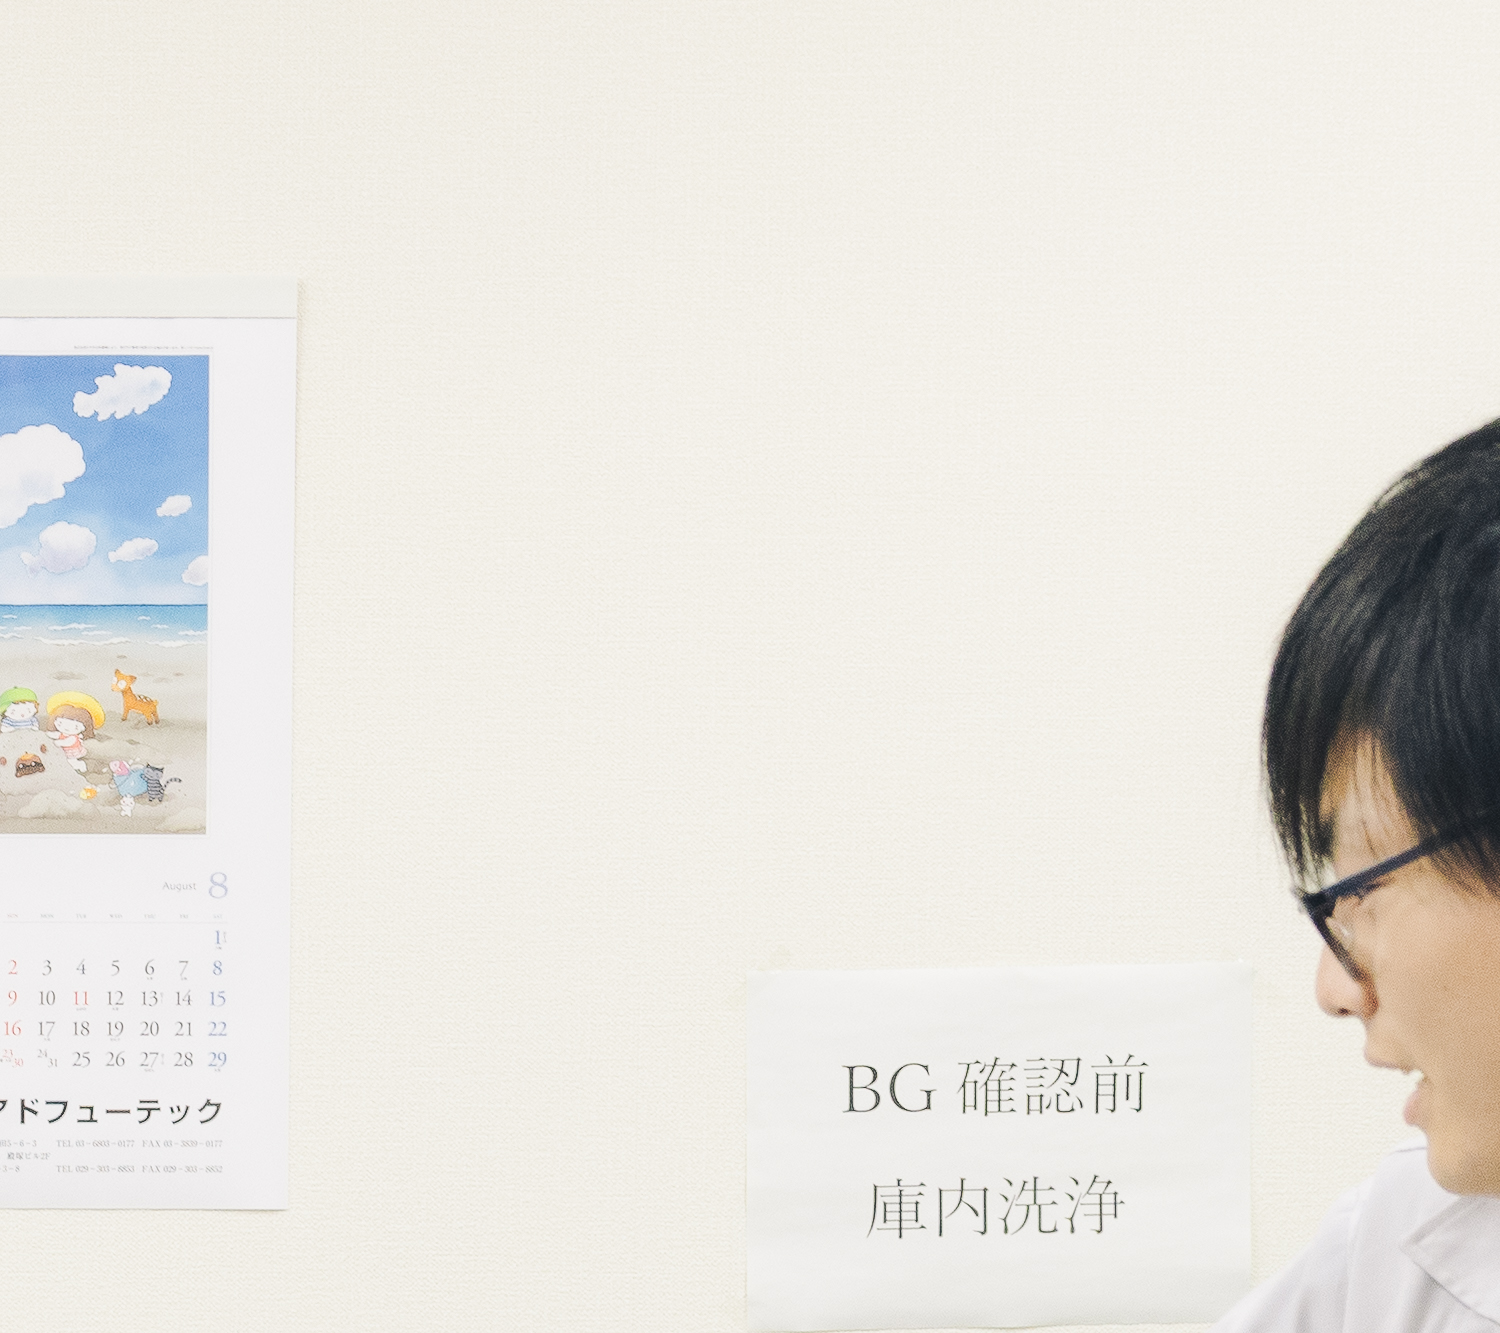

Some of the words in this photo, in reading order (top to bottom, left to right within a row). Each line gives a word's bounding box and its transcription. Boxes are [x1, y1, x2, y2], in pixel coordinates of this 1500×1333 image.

[162, 881, 197, 892] August
[208, 871, 228, 899] 8
[214, 930, 222, 946] 1
[8, 960, 18, 975] 2
[42, 960, 53, 976] 3
[76, 961, 86, 975] 4
[111, 960, 121, 975] 5
[144, 961, 155, 975] 6
[178, 960, 190, 976] 7
[212, 961, 223, 976] 8
[7, 991, 18, 1005] 9
[39, 991, 56, 1006] 10
[73, 991, 89, 1006] 11
[107, 991, 124, 1006] 12
[142, 991, 159, 1007] 13
[176, 991, 192, 1006] 14
[210, 991, 227, 1006] 15
[4, 1021, 22, 1036] 16
[38, 1021, 56, 1036] 17
[73, 1022, 90, 1036] 18
[107, 1022, 125, 1036] 19
[140, 1022, 160, 1037] 20
[175, 1022, 192, 1037] 21
[208, 1022, 227, 1037] 22
[72, 1052, 91, 1067] 25
[106, 1052, 126, 1067] 26
[139, 1052, 160, 1067] 27
[174, 1052, 194, 1067] 28
[208, 1052, 228, 1067] 29
[842, 1062, 938, 1114] BG
[956, 1053, 1150, 1117] 確認前
[56, 1139, 73, 1148] TEL
[142, 1139, 161, 1148] FAX
[56, 1164, 73, 1174] TEL
[142, 1164, 161, 1174] FAX
[866, 1174, 1125, 1239] 庫内洗浄
